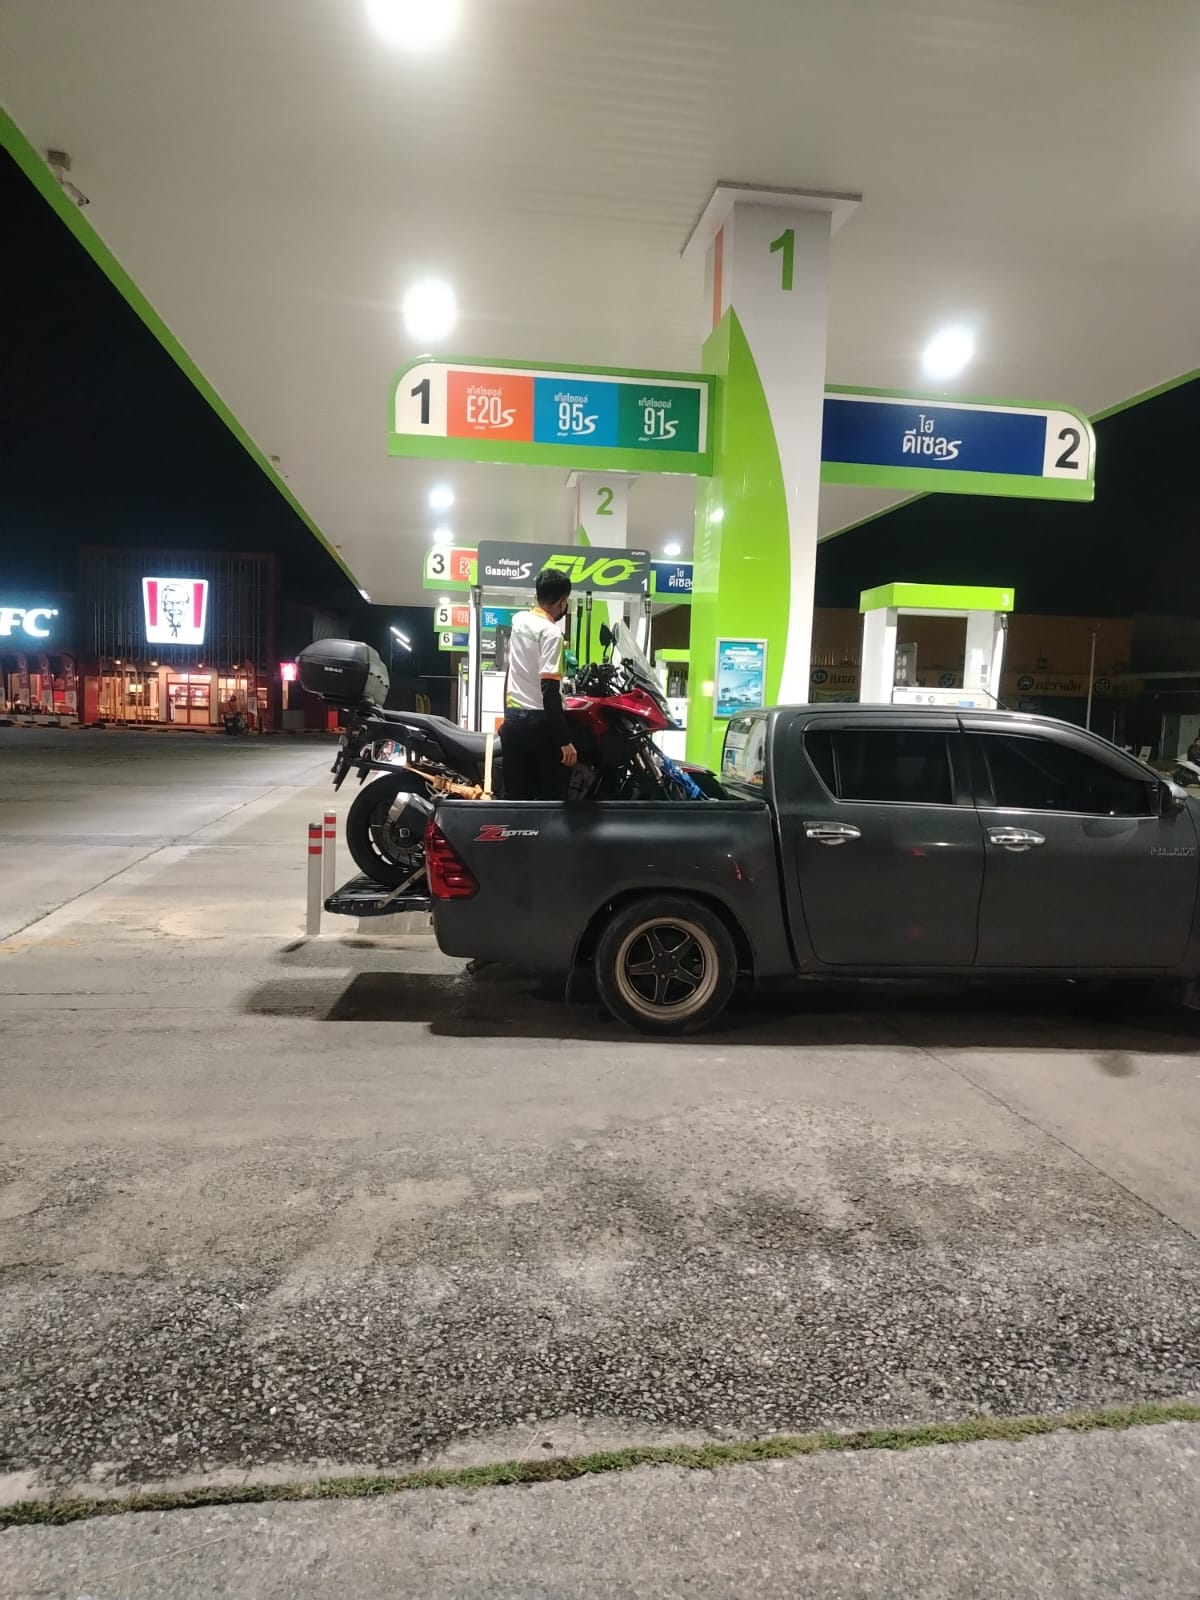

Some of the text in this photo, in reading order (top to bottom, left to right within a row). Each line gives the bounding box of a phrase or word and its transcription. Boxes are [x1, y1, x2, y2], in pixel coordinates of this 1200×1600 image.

[770, 229, 794, 290] 1
[411, 379, 430, 424] 1
[919, 415, 935, 434] ไฮ
[1055, 427, 1081, 469] 2
[596, 487, 614, 515] 2
[432, 553, 445, 574] 3
[459, 560, 471, 575] E2
[485, 565, 520, 577] Gasohol
[533, 554, 645, 586] EVO
[640, 579, 647, 592] 1
[668, 576, 693, 590] ดีเซล
[1001, 593, 1009, 607] 3
[0, 607, 52, 637] FC
[440, 609, 448, 623] 5
[443, 633, 450, 643] 6
[64, 663, 74, 687] KFC
